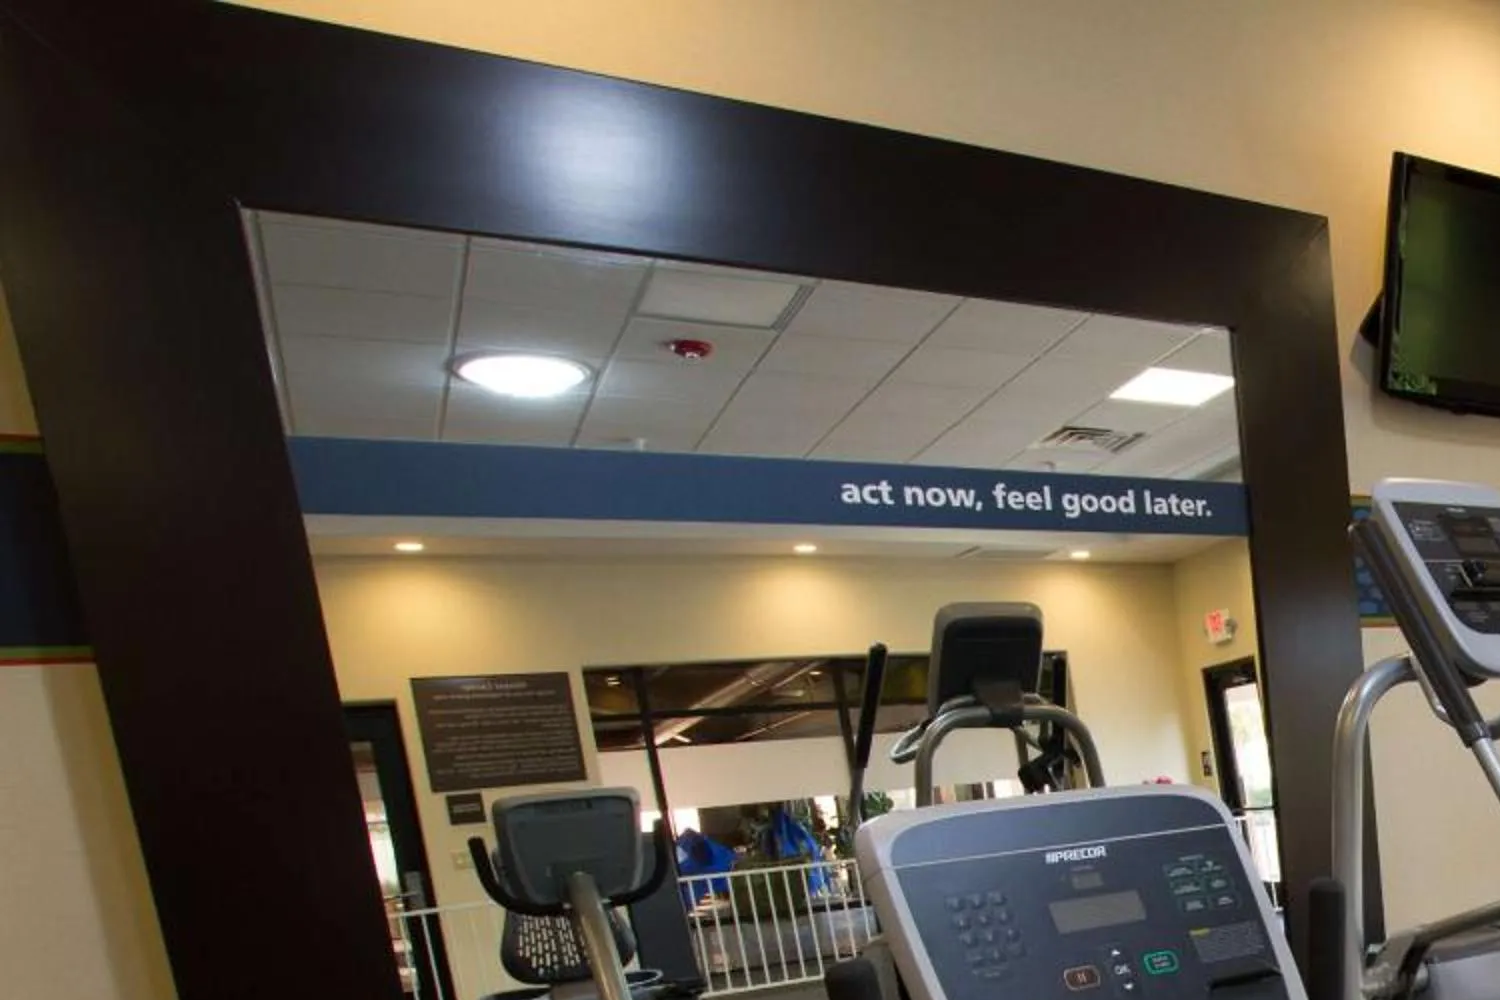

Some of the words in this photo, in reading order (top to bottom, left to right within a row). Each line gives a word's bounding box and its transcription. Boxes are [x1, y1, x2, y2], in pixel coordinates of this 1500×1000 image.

[841, 480, 895, 505] act
[904, 486, 983, 511] now,
[992, 483, 1053, 511] feel
[1061, 489, 1136, 518] good
[1144, 490, 1213, 517] later.
[1054, 845, 1107, 863] PRECOR
